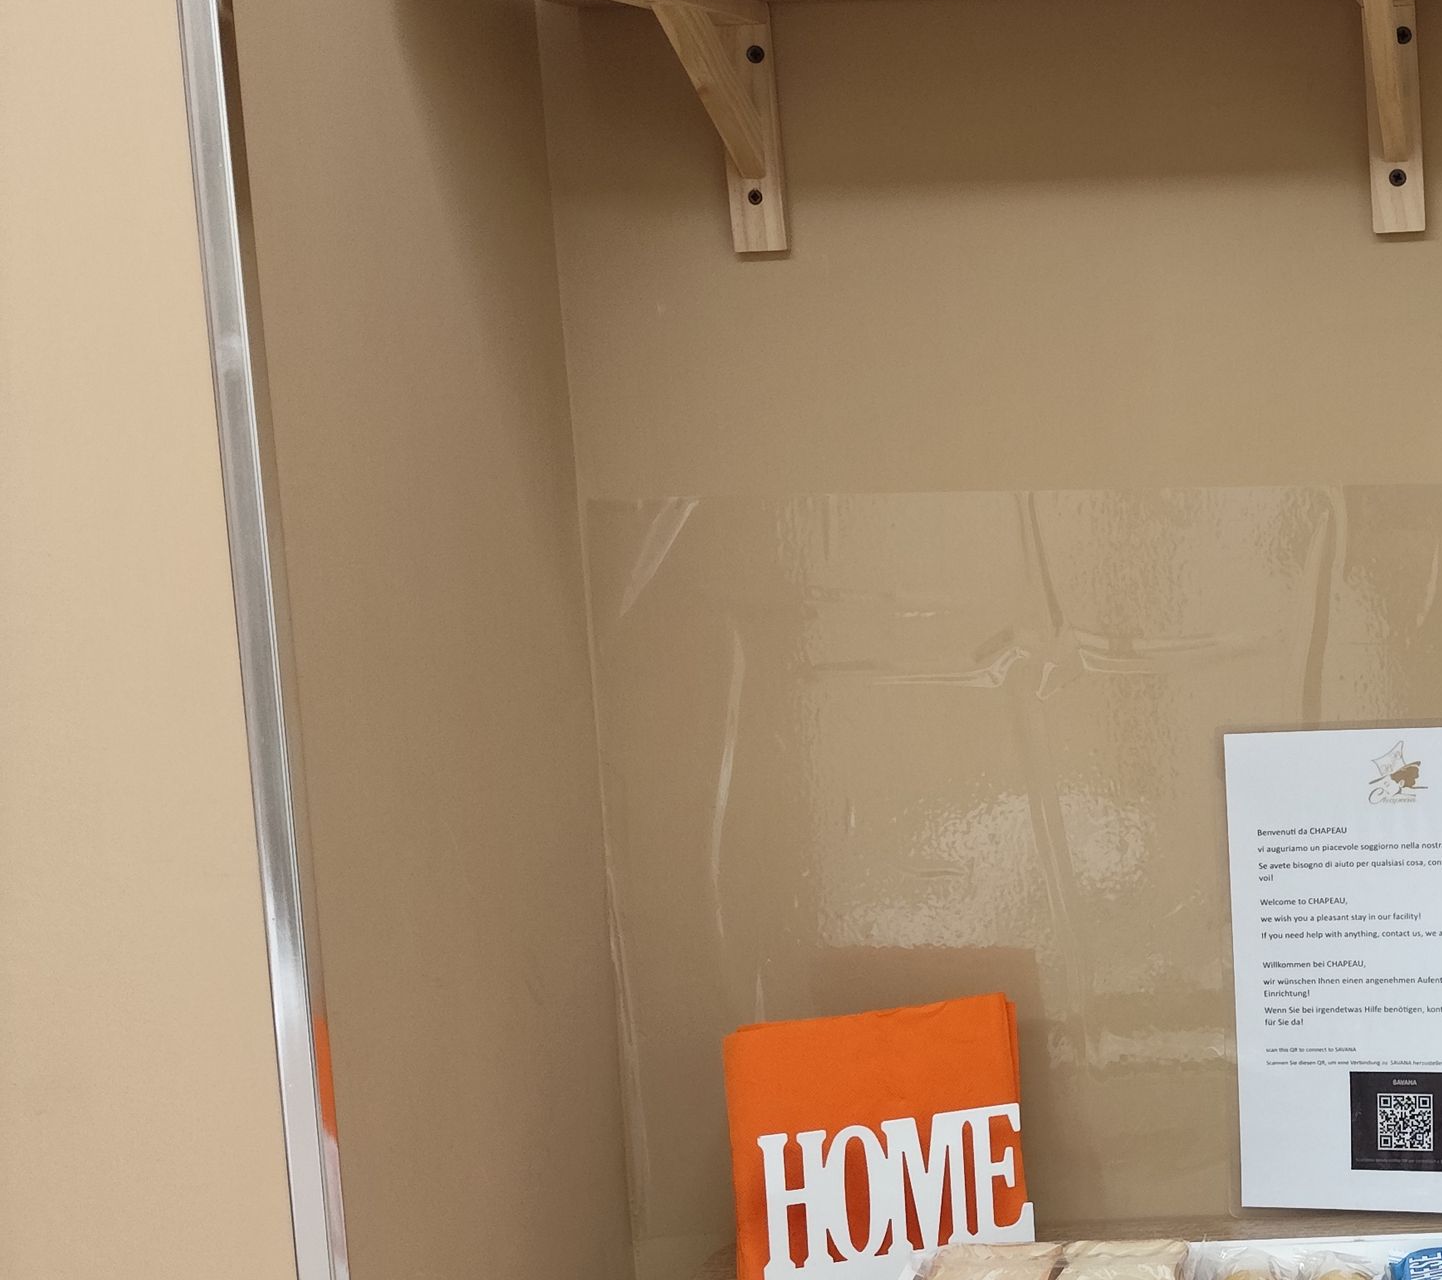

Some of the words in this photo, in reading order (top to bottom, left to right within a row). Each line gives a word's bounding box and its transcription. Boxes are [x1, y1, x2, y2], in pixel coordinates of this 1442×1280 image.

[1257, 828, 1296, 836] Benvenuti
[1266, 845, 1308, 854] auguriamo
[1322, 843, 1359, 852] piacevole
[1360, 842, 1399, 851] soggiorno
[1258, 862, 1268, 870] Se
[1293, 861, 1323, 870] bisogno
[1325, 860, 1333, 868] di
[1334, 860, 1355, 868] aiuto
[1356, 861, 1369, 869] per
[1371, 859, 1405, 868] qualsiasi
[1258, 874, 1274, 882] voi!
[1260, 897, 1296, 906] Welcome
[1274, 914, 1292, 923] wish
[1293, 915, 1309, 924] you
[1316, 914, 1349, 923] pleasant
[1351, 914, 1366, 922] stay
[1368, 913, 1376, 921] in
[1393, 912, 1422, 921] facility!
[1261, 932, 1268, 940] If
[1269, 932, 1283, 940] you
[1285, 931, 1305, 939] need
[1306, 931, 1323, 940] help
[1325, 930, 1343, 939] with
[1344, 930, 1380, 939] anything,
[1381, 930, 1410, 938] contact
[1262, 960, 1311, 969] Willkommen
[1313, 960, 1325, 968] bei
[1263, 978, 1276, 986] wir
[1277, 977, 1317, 985] wünschen
[1318, 977, 1341, 985] Ihnen
[1342, 977, 1364, 985] einen
[1365, 977, 1416, 986] angenehmen
[1263, 990, 1310, 999] Einrichtung!
[1264, 1007, 1287, 1015] Wenn
[1288, 1006, 1301, 1014] Sie
[1302, 1006, 1314, 1014] bei
[1315, 1006, 1363, 1015] irgendetwas
[1364, 1005, 1382, 1013] Hilfe
[1264, 1018, 1276, 1026] für
[1277, 1018, 1289, 1026] Sie
[1291, 1018, 1304, 1026] da!
[756, 1102, 1036, 1269] HOME
